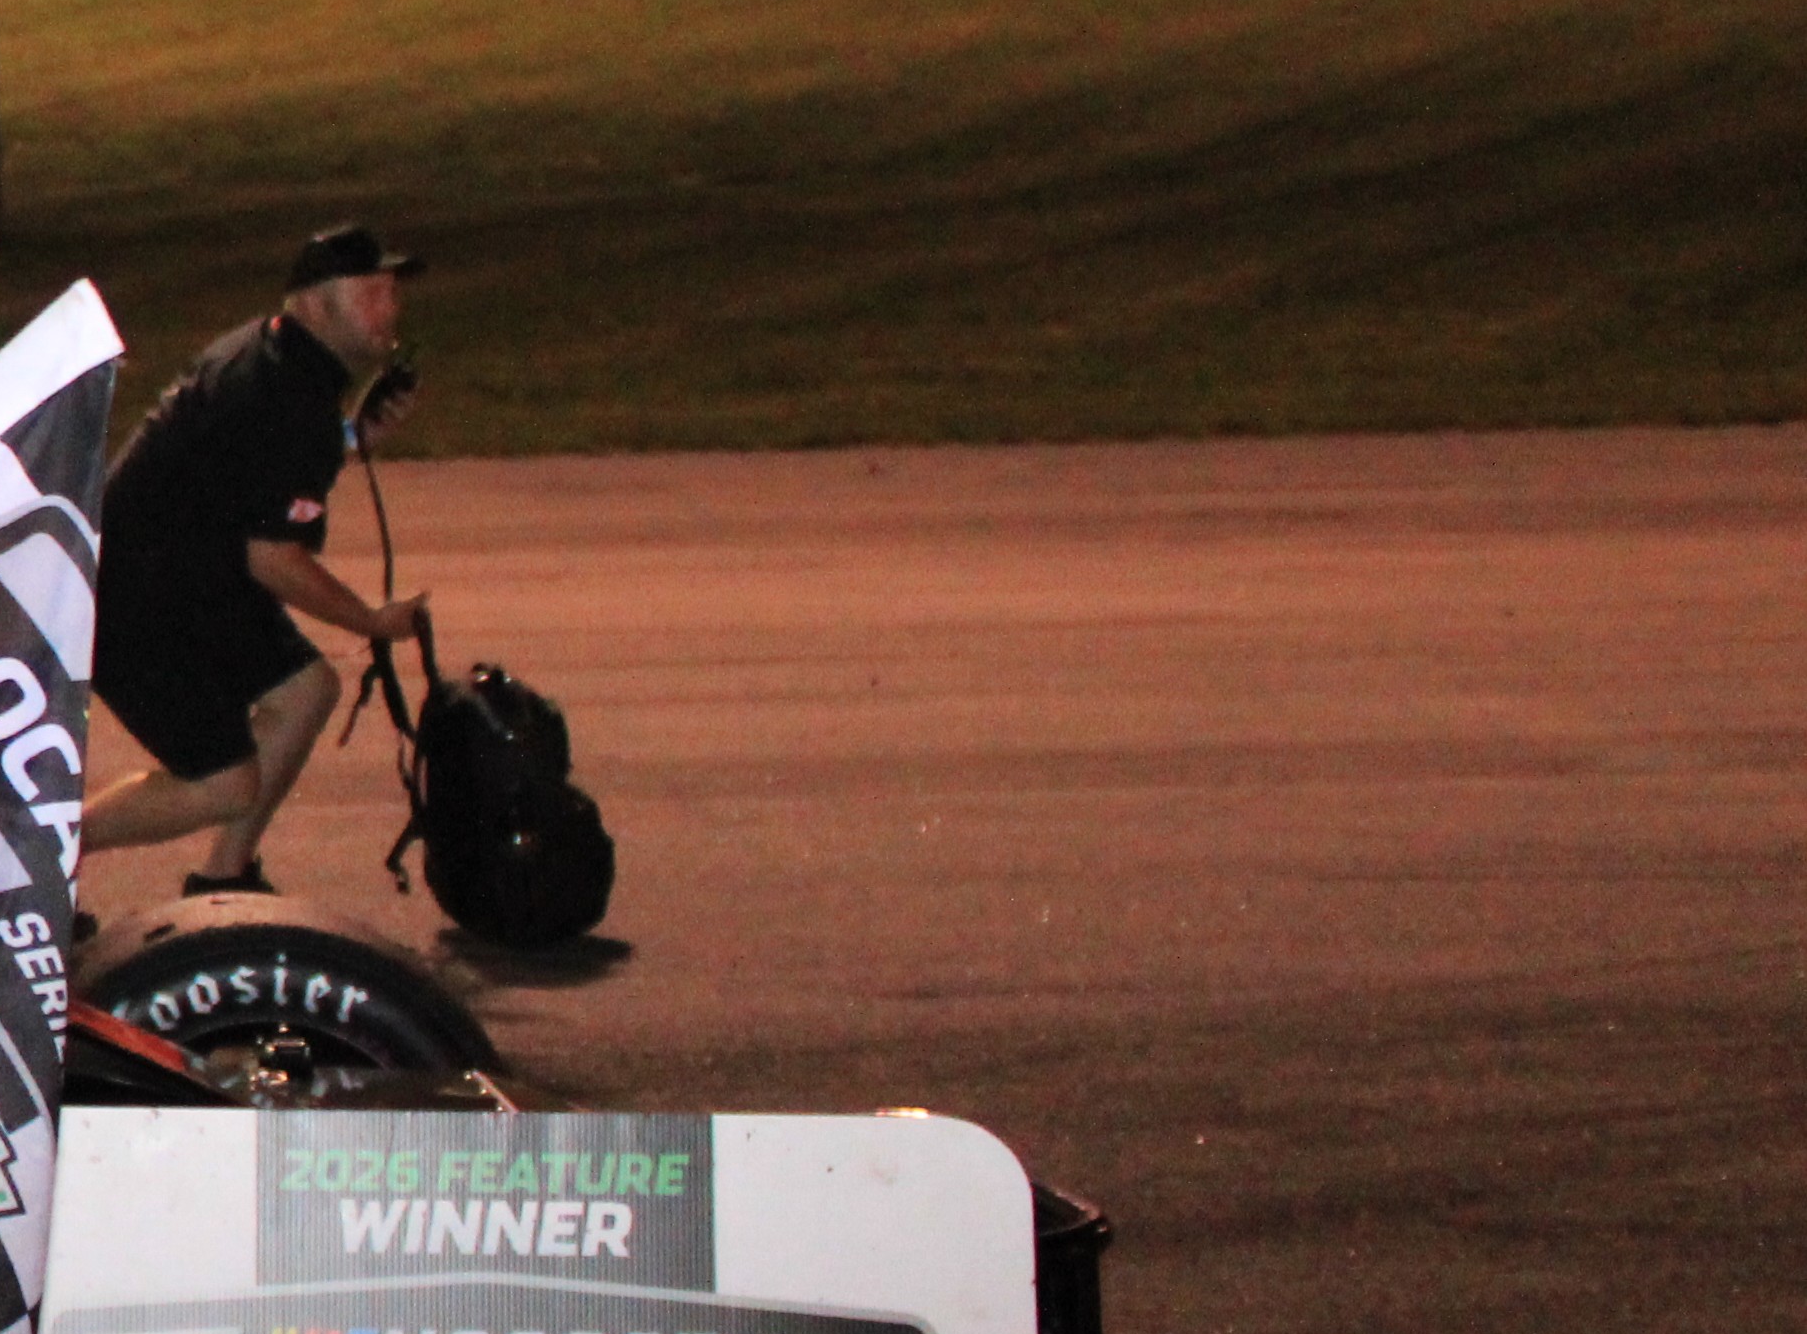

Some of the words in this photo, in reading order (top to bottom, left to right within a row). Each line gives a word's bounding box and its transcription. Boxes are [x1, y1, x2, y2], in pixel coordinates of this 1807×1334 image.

[110, 953, 370, 1032] oosier
[281, 1150, 418, 1194] 2026
[437, 1151, 689, 1197] FEATURE
[340, 1199, 633, 1259] WINNER
